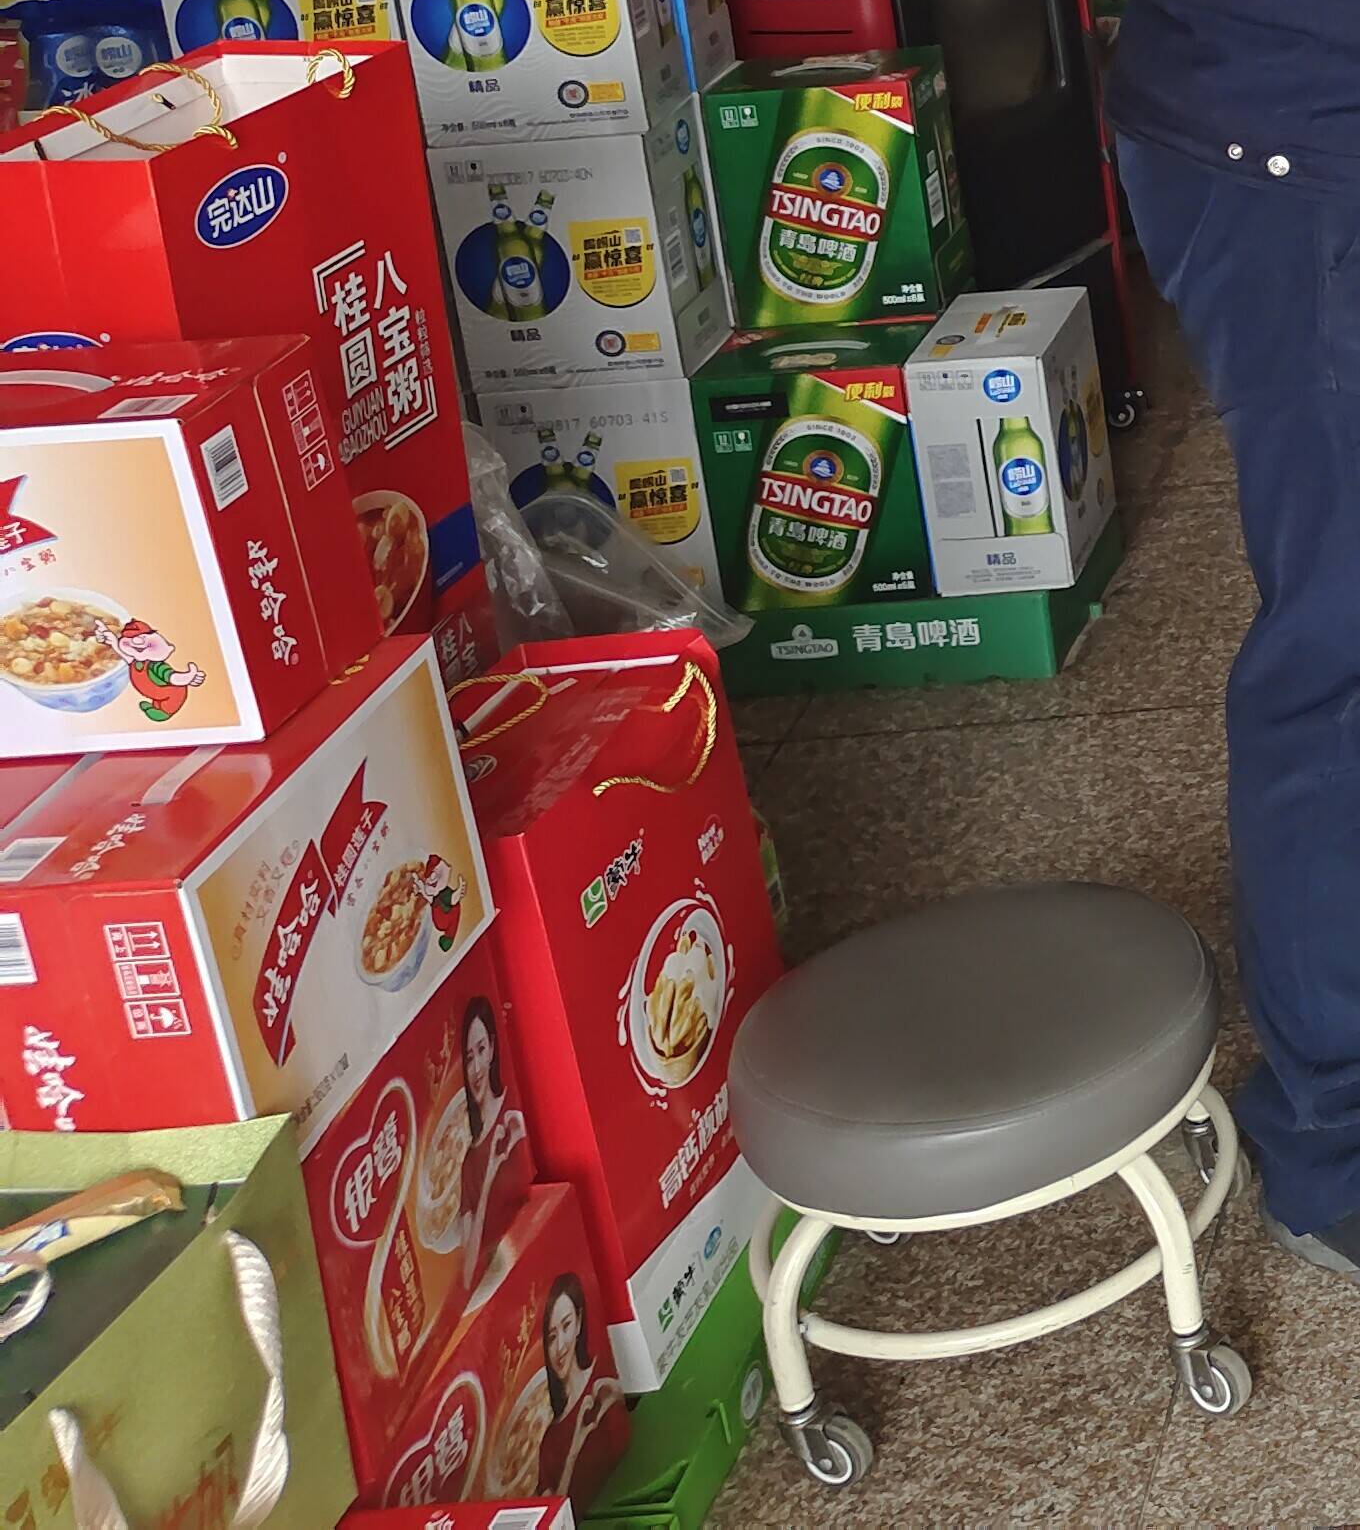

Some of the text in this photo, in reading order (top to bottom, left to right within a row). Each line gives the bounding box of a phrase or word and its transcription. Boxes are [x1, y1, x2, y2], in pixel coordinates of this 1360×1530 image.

[206, 174, 276, 239] 完达山
[771, 189, 881, 236] TSINGTAO
[779, 228, 858, 263] 青岛啤酒
[331, 271, 378, 400] 桂圆
[373, 250, 423, 425] 八宝粥
[759, 476, 874, 524] TSINGTAO
[767, 516, 850, 551] 青岛啤酒
[985, 552, 1017, 566] 精品
[247, 539, 297, 667] 娃哈哈
[775, 643, 834, 656] TSINGTAO
[851, 617, 982, 654] 青岛啤酒
[22, 1024, 86, 1133] 娃哈
